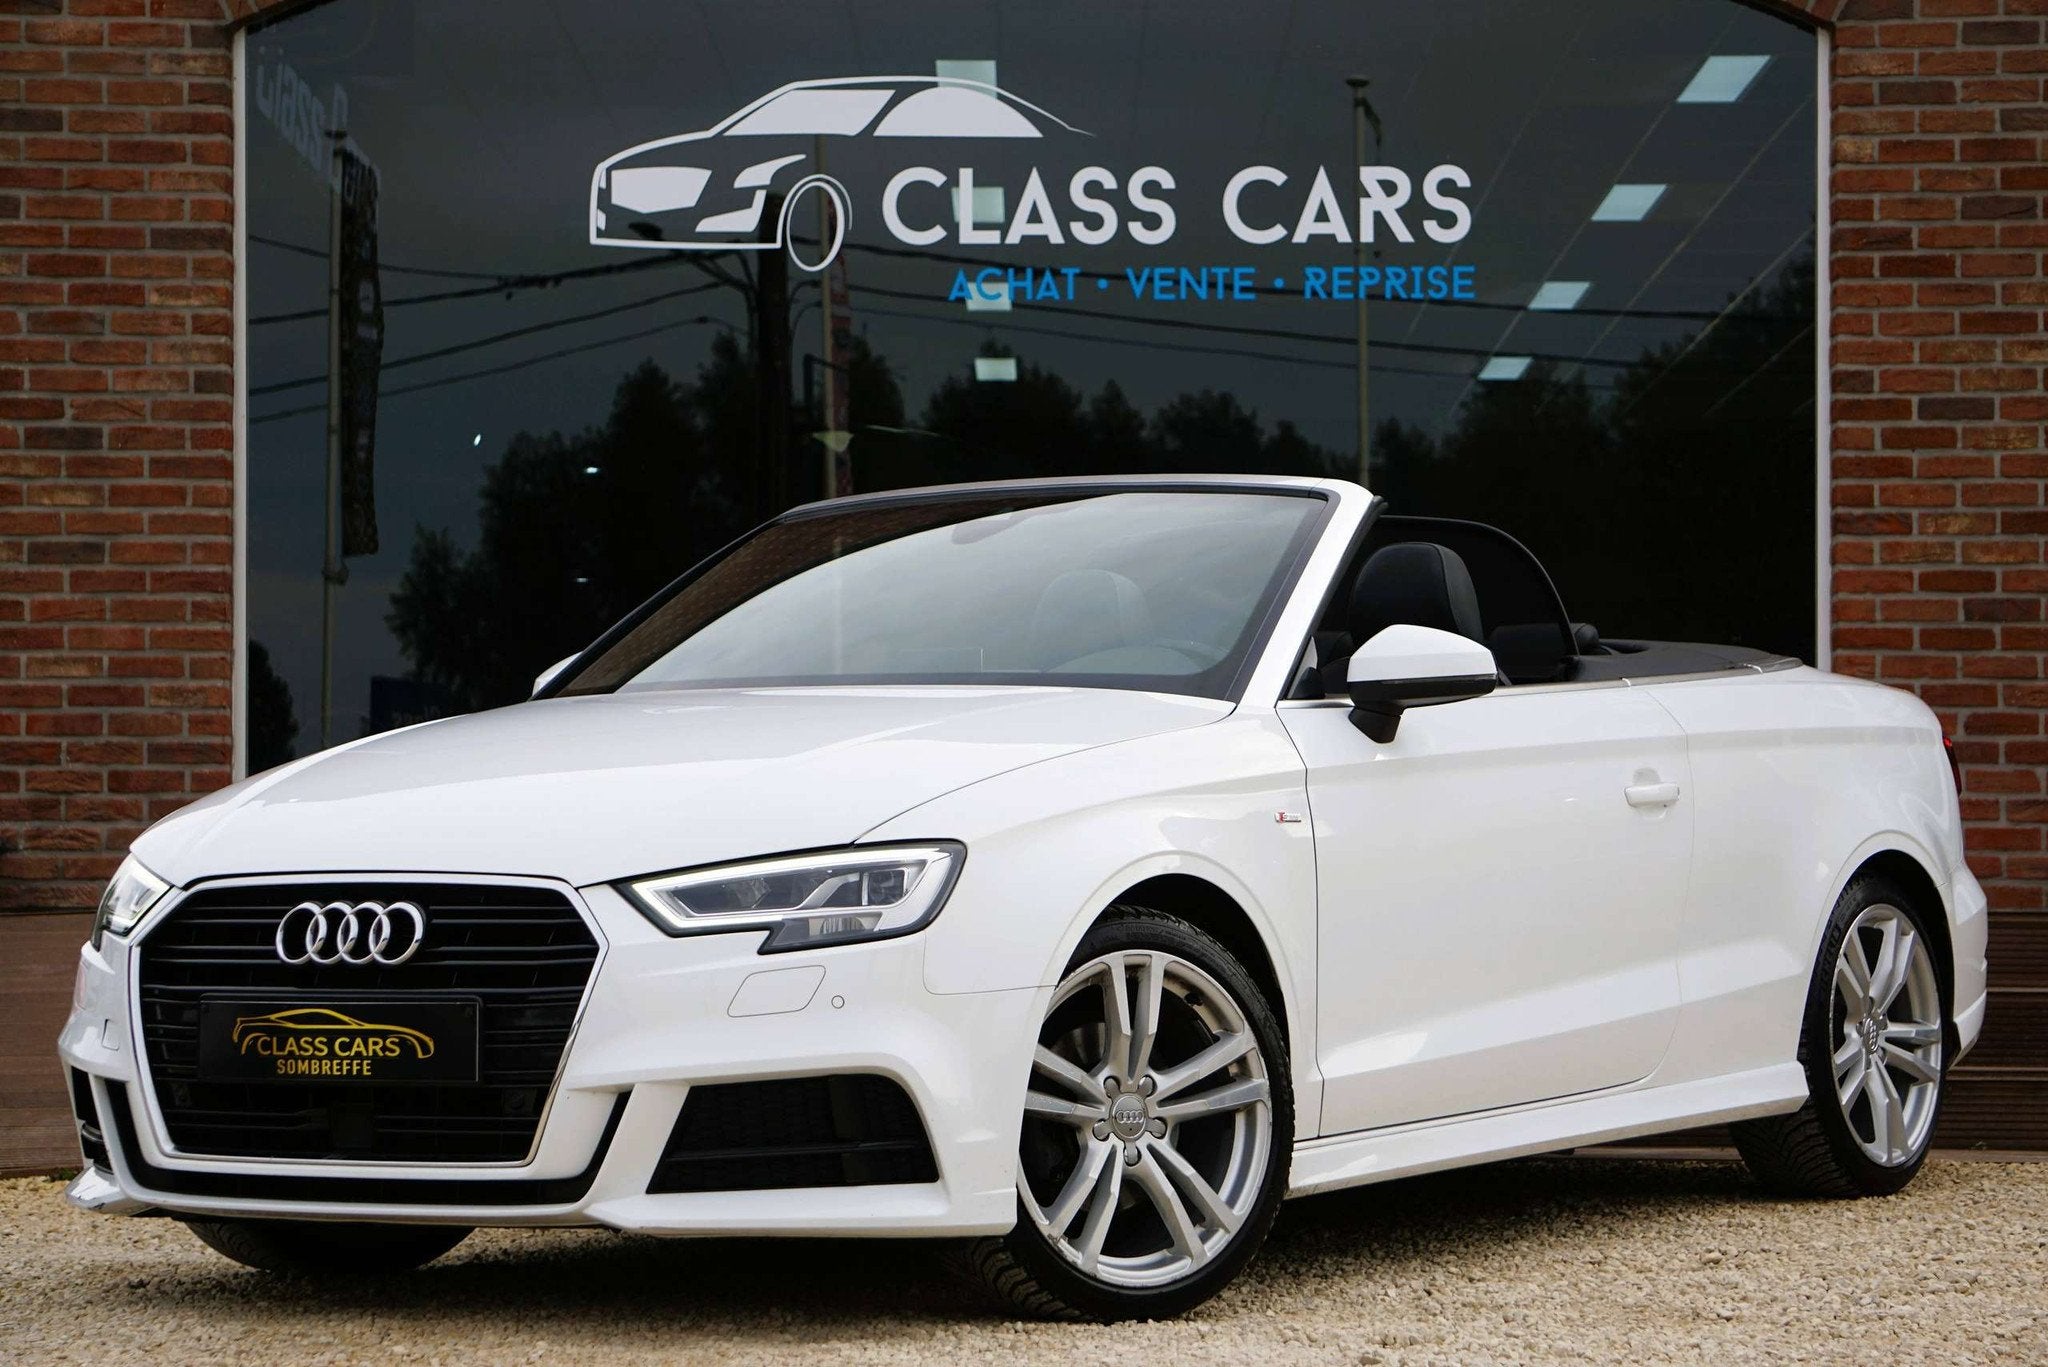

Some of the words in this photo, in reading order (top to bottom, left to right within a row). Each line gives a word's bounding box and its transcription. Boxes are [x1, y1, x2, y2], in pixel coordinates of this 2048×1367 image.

[882, 165, 1176, 245] CLASS
[1222, 164, 1472, 244] CARS
[948, 267, 1081, 301] ACHAT
[1125, 267, 1257, 300] VENTE
[1304, 266, 1475, 300] REPRISE
[257, 1036, 328, 1057] CLASS
[333, 1036, 401, 1057] CARS
[276, 1059, 372, 1076] SOMBREFFE
